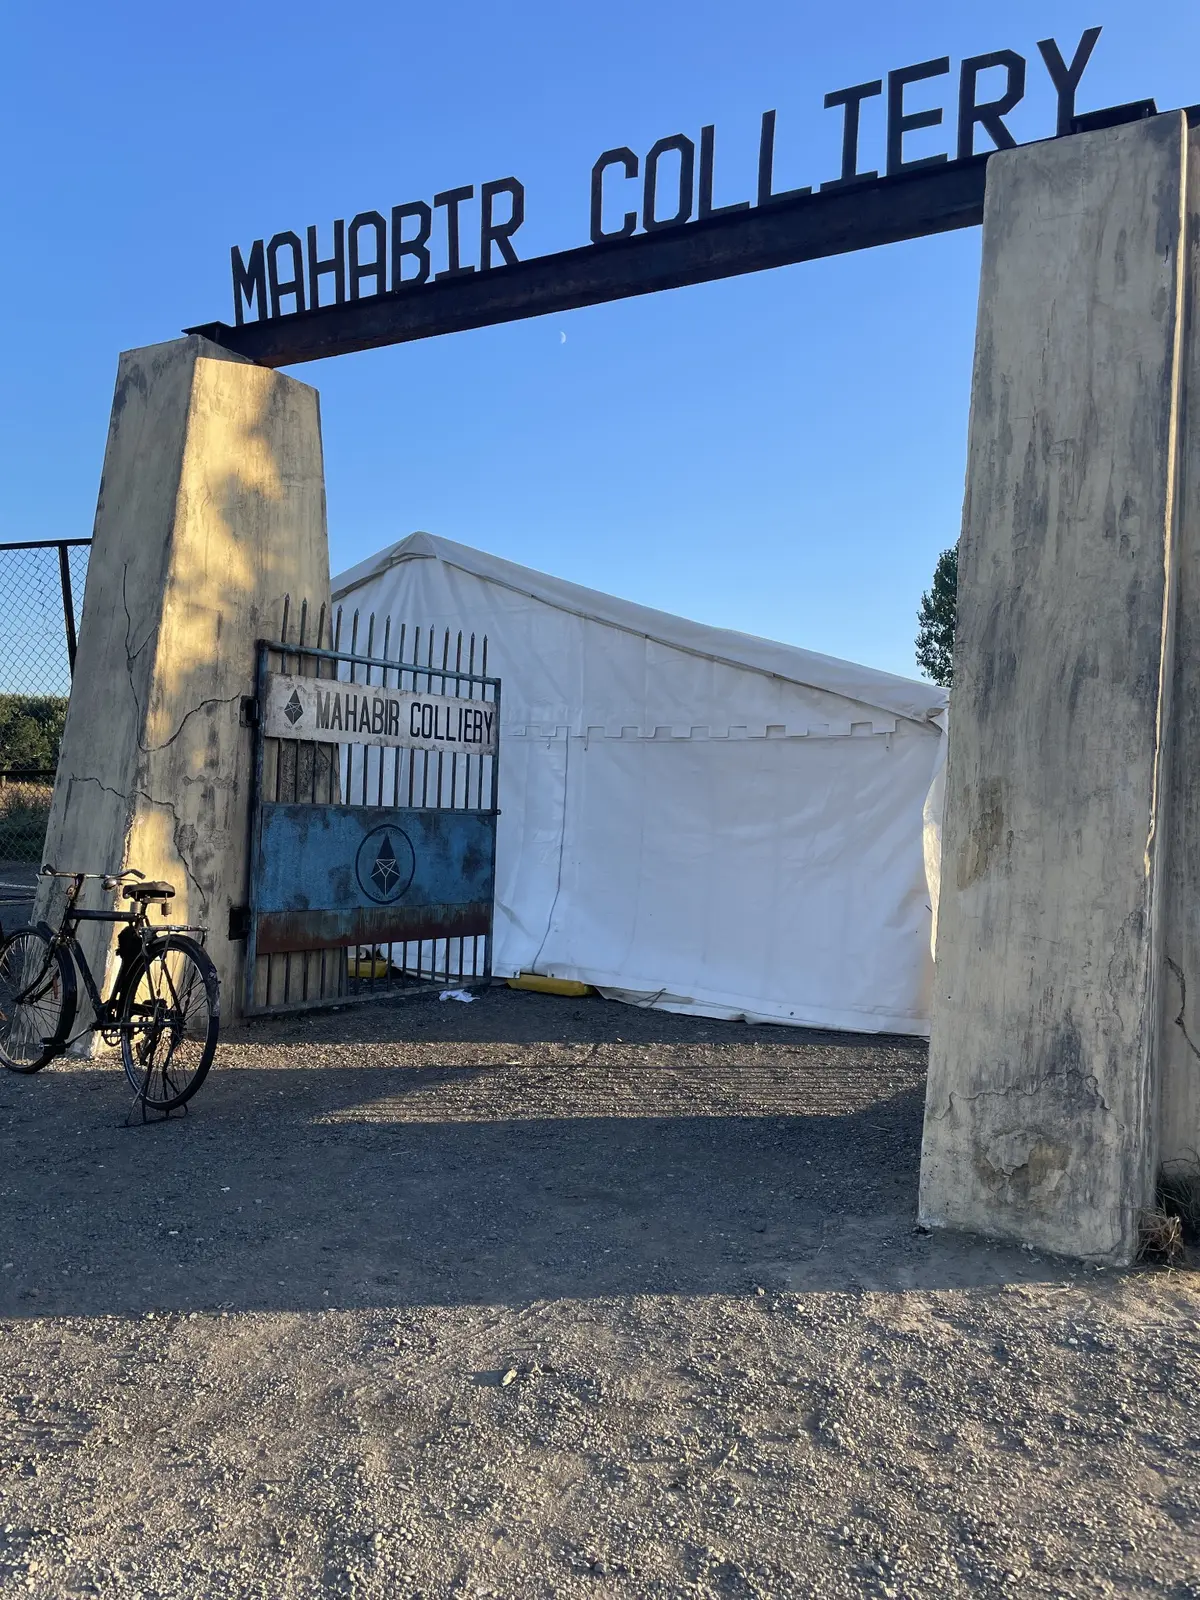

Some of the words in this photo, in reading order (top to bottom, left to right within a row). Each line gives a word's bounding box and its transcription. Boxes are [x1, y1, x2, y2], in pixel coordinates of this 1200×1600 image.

[230, 176, 525, 327] MAHABIR
[590, 26, 1103, 245] COLLIERY
[315, 690, 400, 737] MAHABIR
